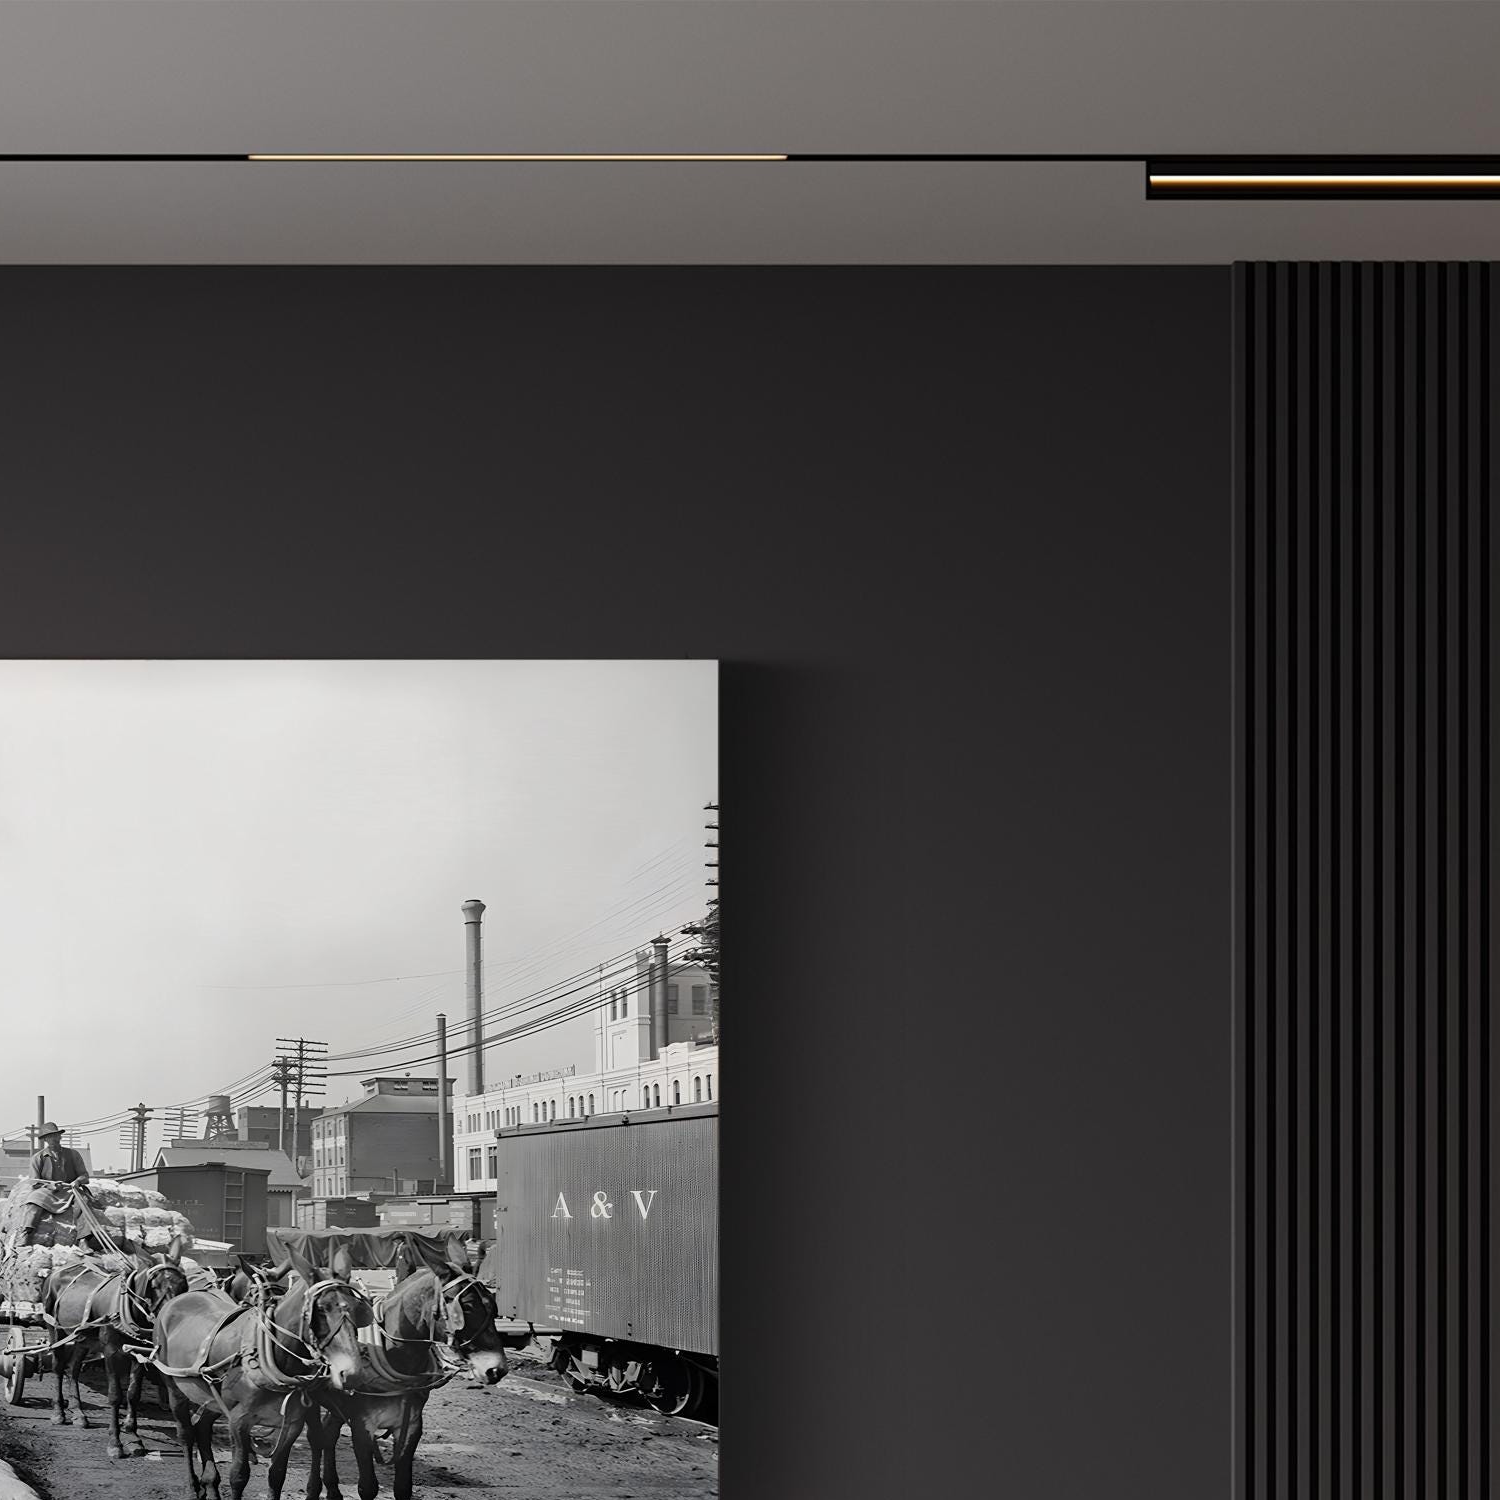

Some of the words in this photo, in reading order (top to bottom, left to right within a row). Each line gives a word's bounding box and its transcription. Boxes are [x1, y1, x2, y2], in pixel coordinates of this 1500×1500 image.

[550, 1191, 573, 1219] A
[590, 1190, 613, 1219] &
[629, 1190, 658, 1220] V
